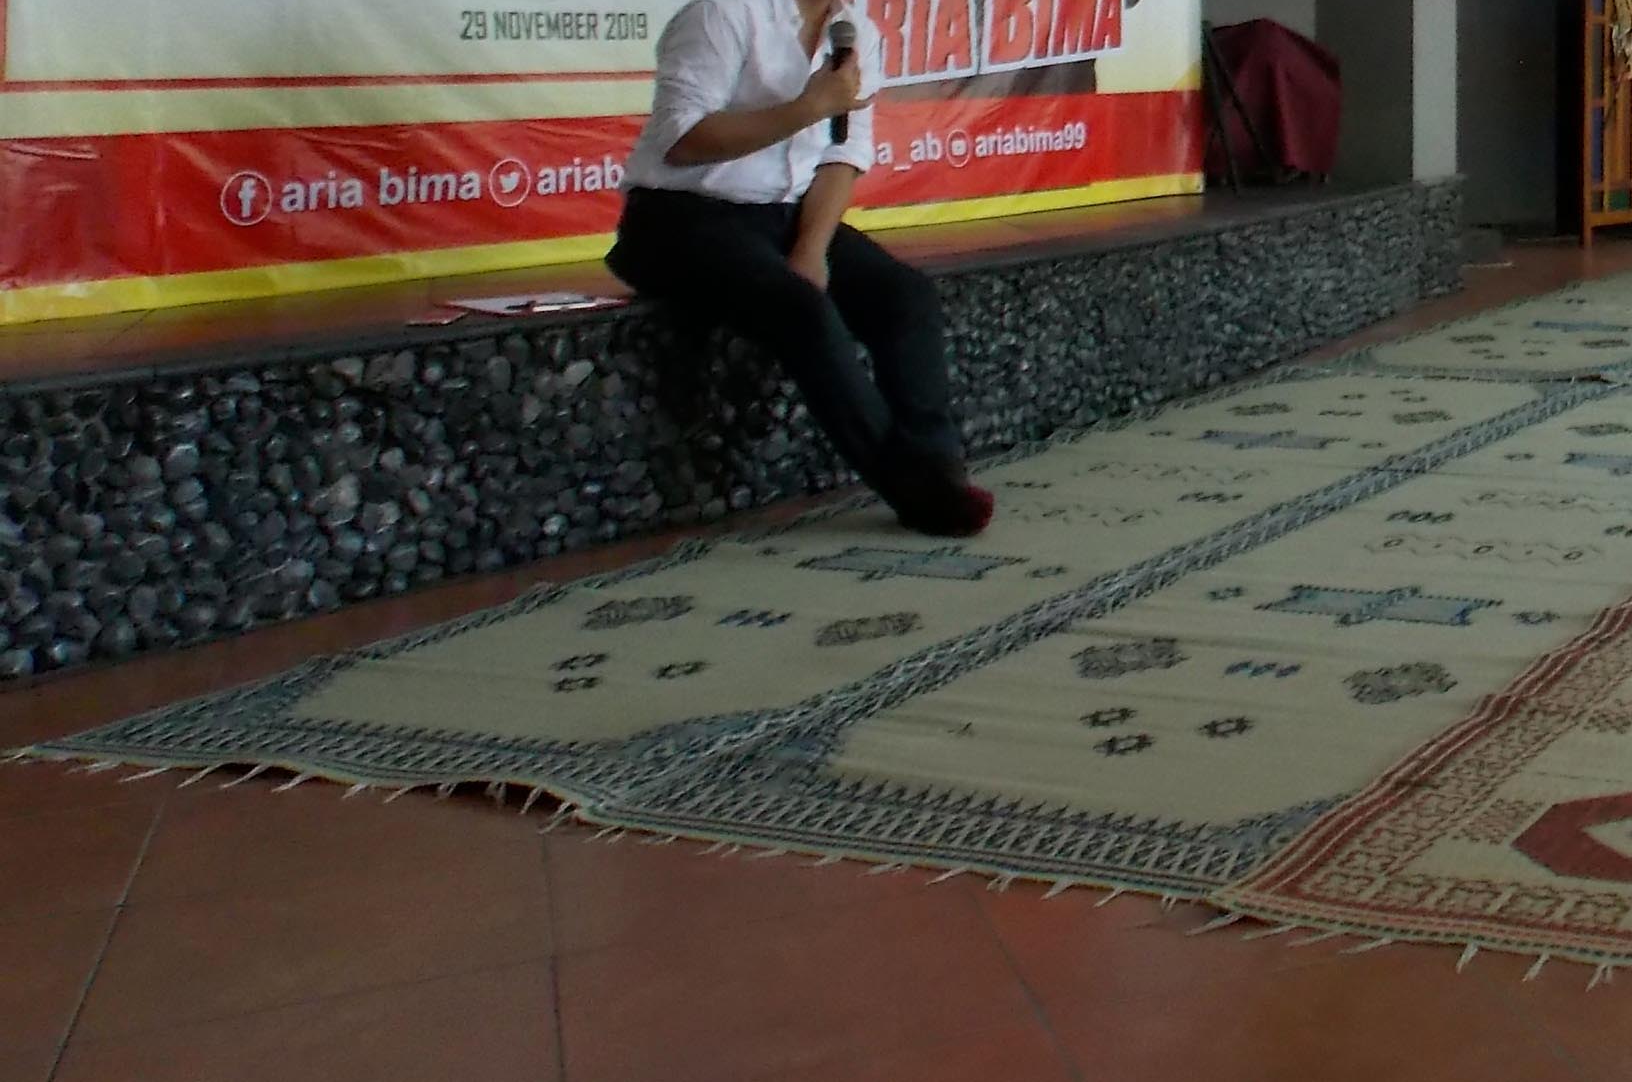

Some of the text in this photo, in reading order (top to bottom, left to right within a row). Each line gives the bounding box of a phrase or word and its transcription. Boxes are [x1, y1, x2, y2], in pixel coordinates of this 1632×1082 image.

[460, 10, 649, 40] 29 NOVEMBER 2019
[279, 168, 364, 214] aria
[379, 166, 481, 207] bima
[536, 154, 626, 196] ariab
[874, 131, 943, 172] a_ab
[974, 121, 1088, 159] ariabima99
